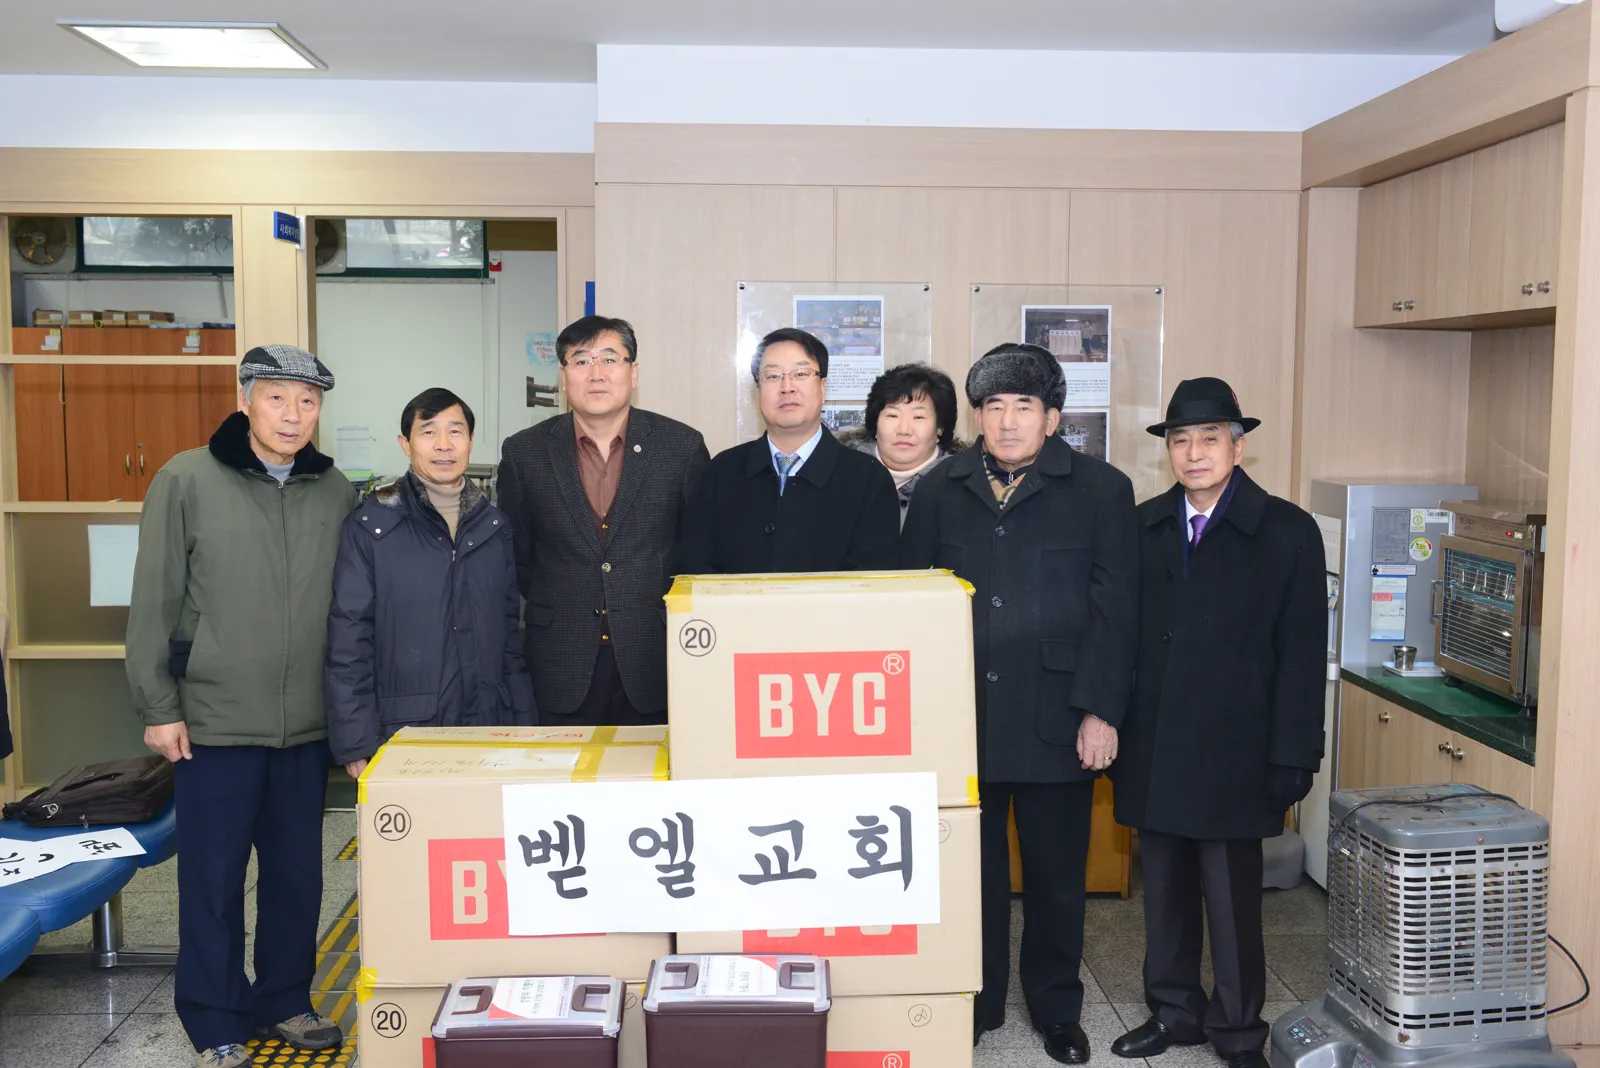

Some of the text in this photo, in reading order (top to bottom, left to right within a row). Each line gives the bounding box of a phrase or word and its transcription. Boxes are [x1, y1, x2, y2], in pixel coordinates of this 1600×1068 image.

[683, 626, 713, 650] 20
[758, 672, 886, 737] BYC
[378, 811, 408, 835] 20
[375, 1009, 403, 1032] 20
